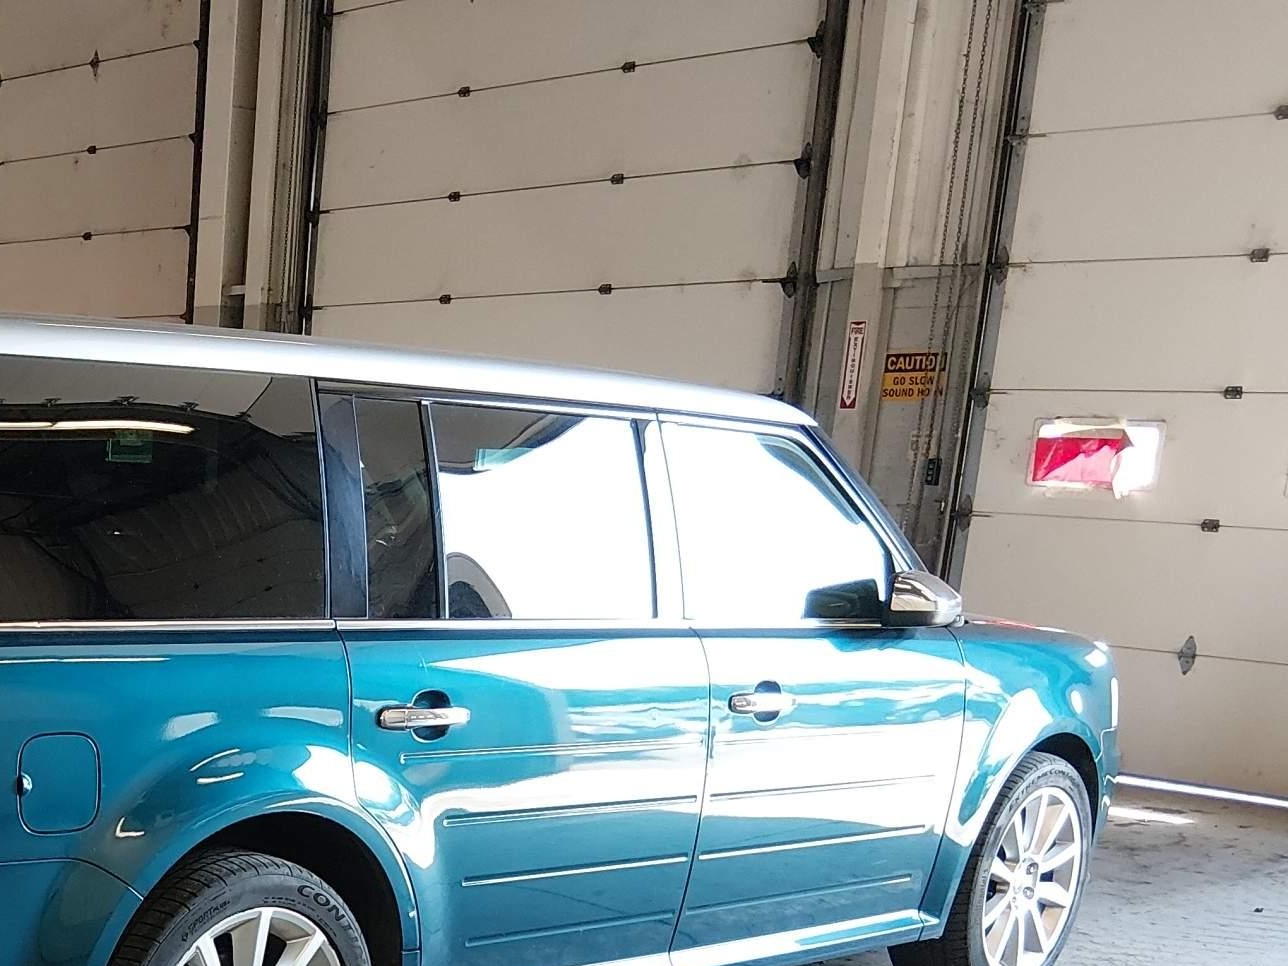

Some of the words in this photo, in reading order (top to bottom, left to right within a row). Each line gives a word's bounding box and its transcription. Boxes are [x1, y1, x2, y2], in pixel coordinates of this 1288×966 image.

[851, 326, 864, 335] FIRE
[892, 376, 906, 386] GO
[882, 387, 914, 398] SOUND
[917, 386, 943, 397] HON
